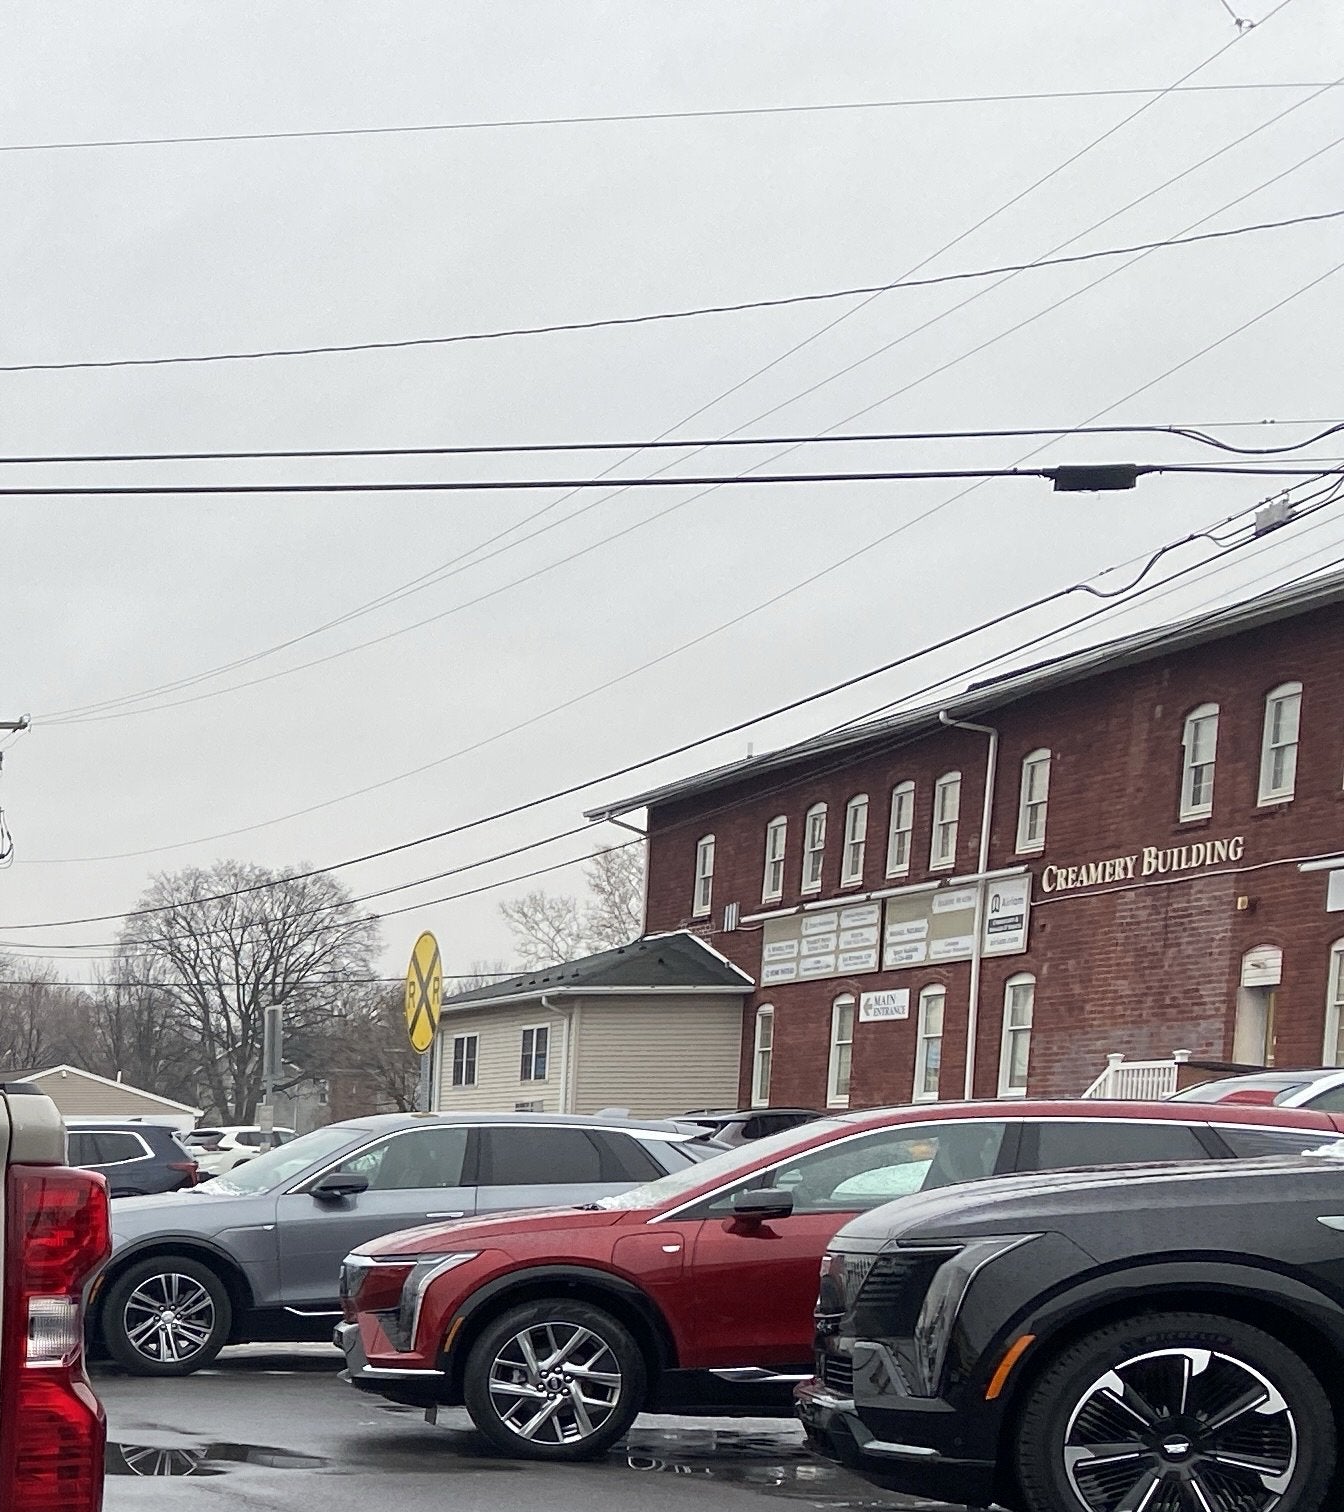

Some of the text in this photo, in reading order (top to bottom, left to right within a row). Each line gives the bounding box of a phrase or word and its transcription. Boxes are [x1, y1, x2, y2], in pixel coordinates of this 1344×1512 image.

[1042, 836, 1244, 892] CREAMERY BUILDING
[874, 993, 897, 1006] MAIN
[873, 1005, 906, 1017] ENTRANCE
